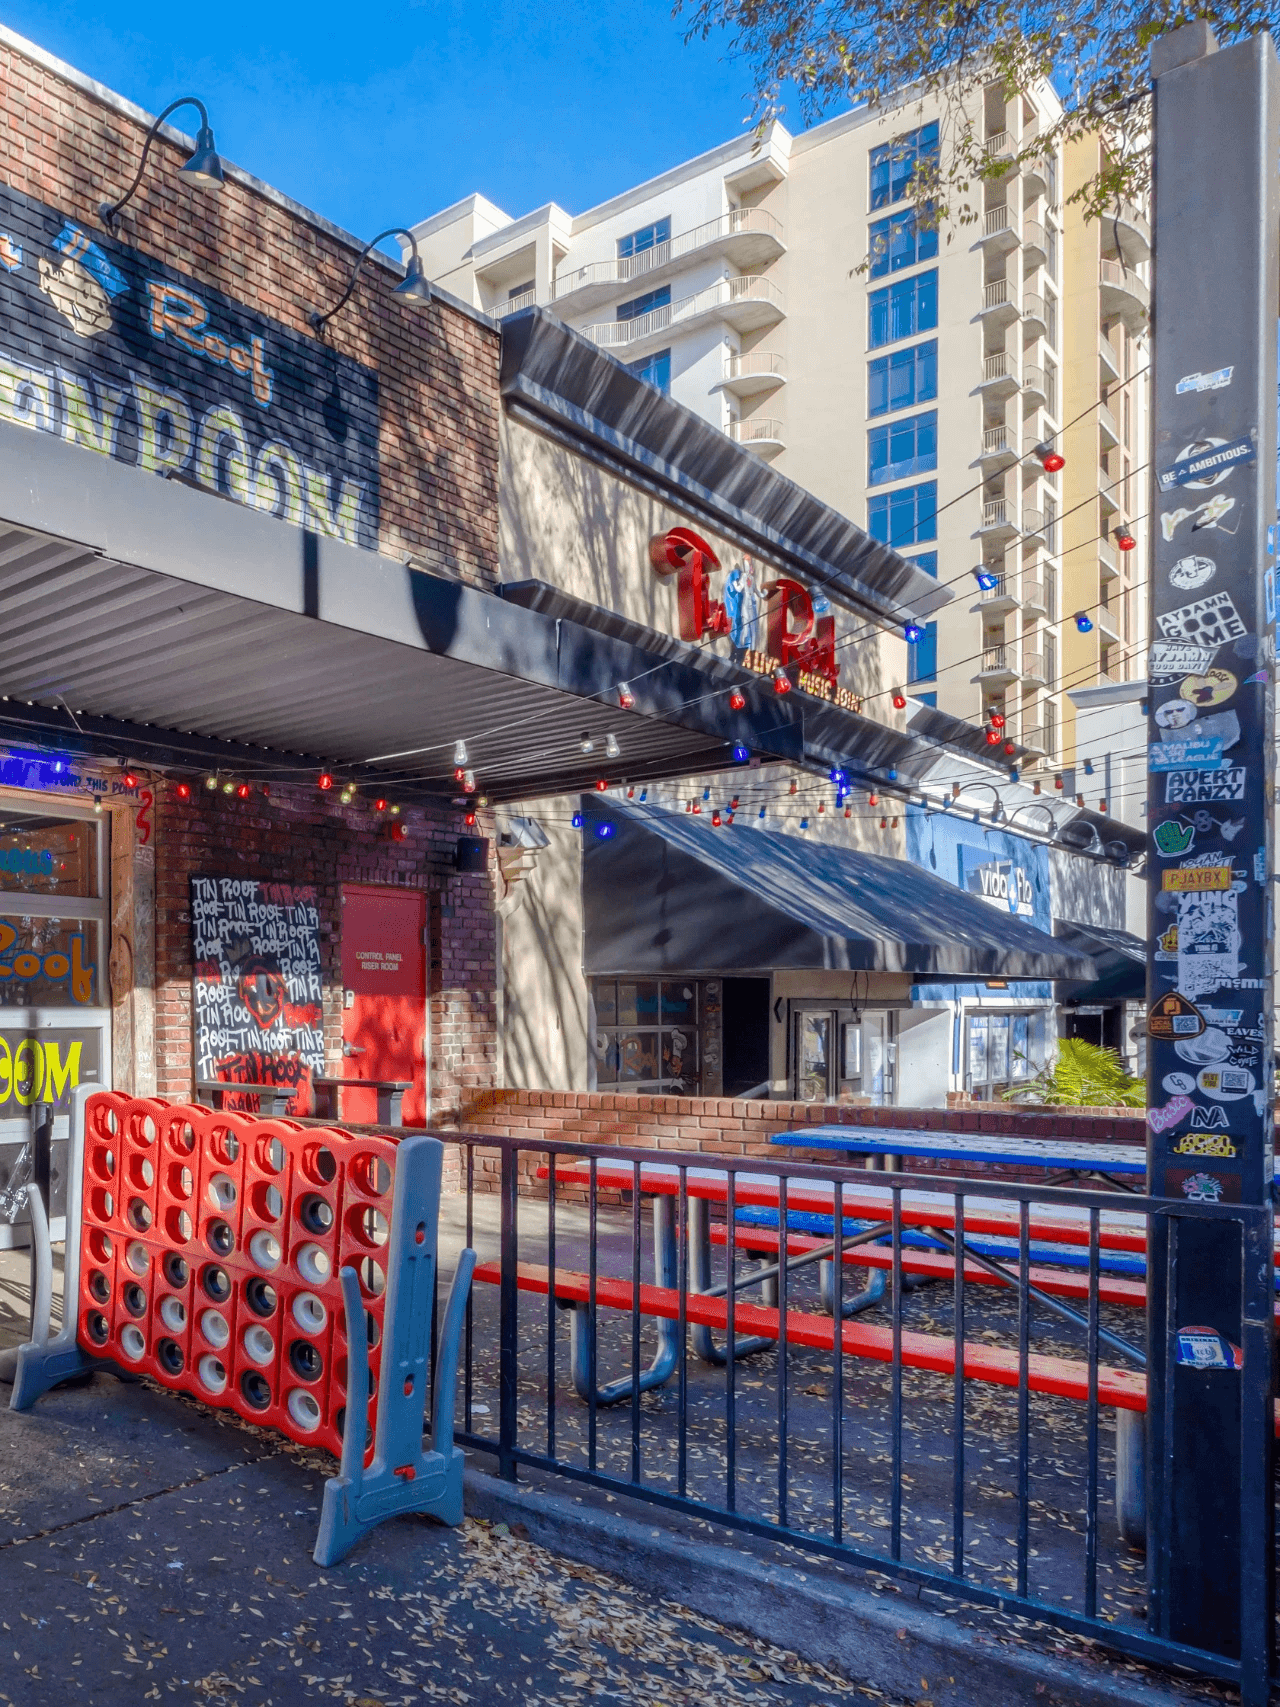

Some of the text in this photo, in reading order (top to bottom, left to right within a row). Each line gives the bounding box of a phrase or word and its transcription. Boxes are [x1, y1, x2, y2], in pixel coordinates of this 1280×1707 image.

[145, 278, 275, 407] Roof
[1162, 471, 1177, 484] BE
[798, 669, 832, 701] MUSIC
[833, 686, 865, 714] JOINT
[86, 777, 109, 792] THIS
[192, 878, 218, 901] TIN
[219, 878, 260, 901] ROOF
[192, 899, 224, 919] ROOF
[224, 896, 247, 920] TIN
[247, 903, 283, 923] ROOF
[285, 902, 307, 925] TIN
[193, 917, 217, 939] TIN
[255, 919, 277, 939] TIN
[277, 921, 316, 941] ROOF
[284, 939, 306, 960] TIN
[356, 951, 402, 961] CONTROL PANEL
[280, 958, 318, 979] ROOF
[362, 962, 379, 970] RISER
[195, 982, 236, 1006] ROOF
[286, 975, 308, 1003] TIN
[196, 1003, 220, 1026] TIN
[220, 1002, 251, 1026] ROO
[200, 1026, 238, 1054] ROOF
[239, 1025, 261, 1051] TIN
[260, 1027, 291, 1053] ROOF
[292, 1023, 313, 1050] TIN
